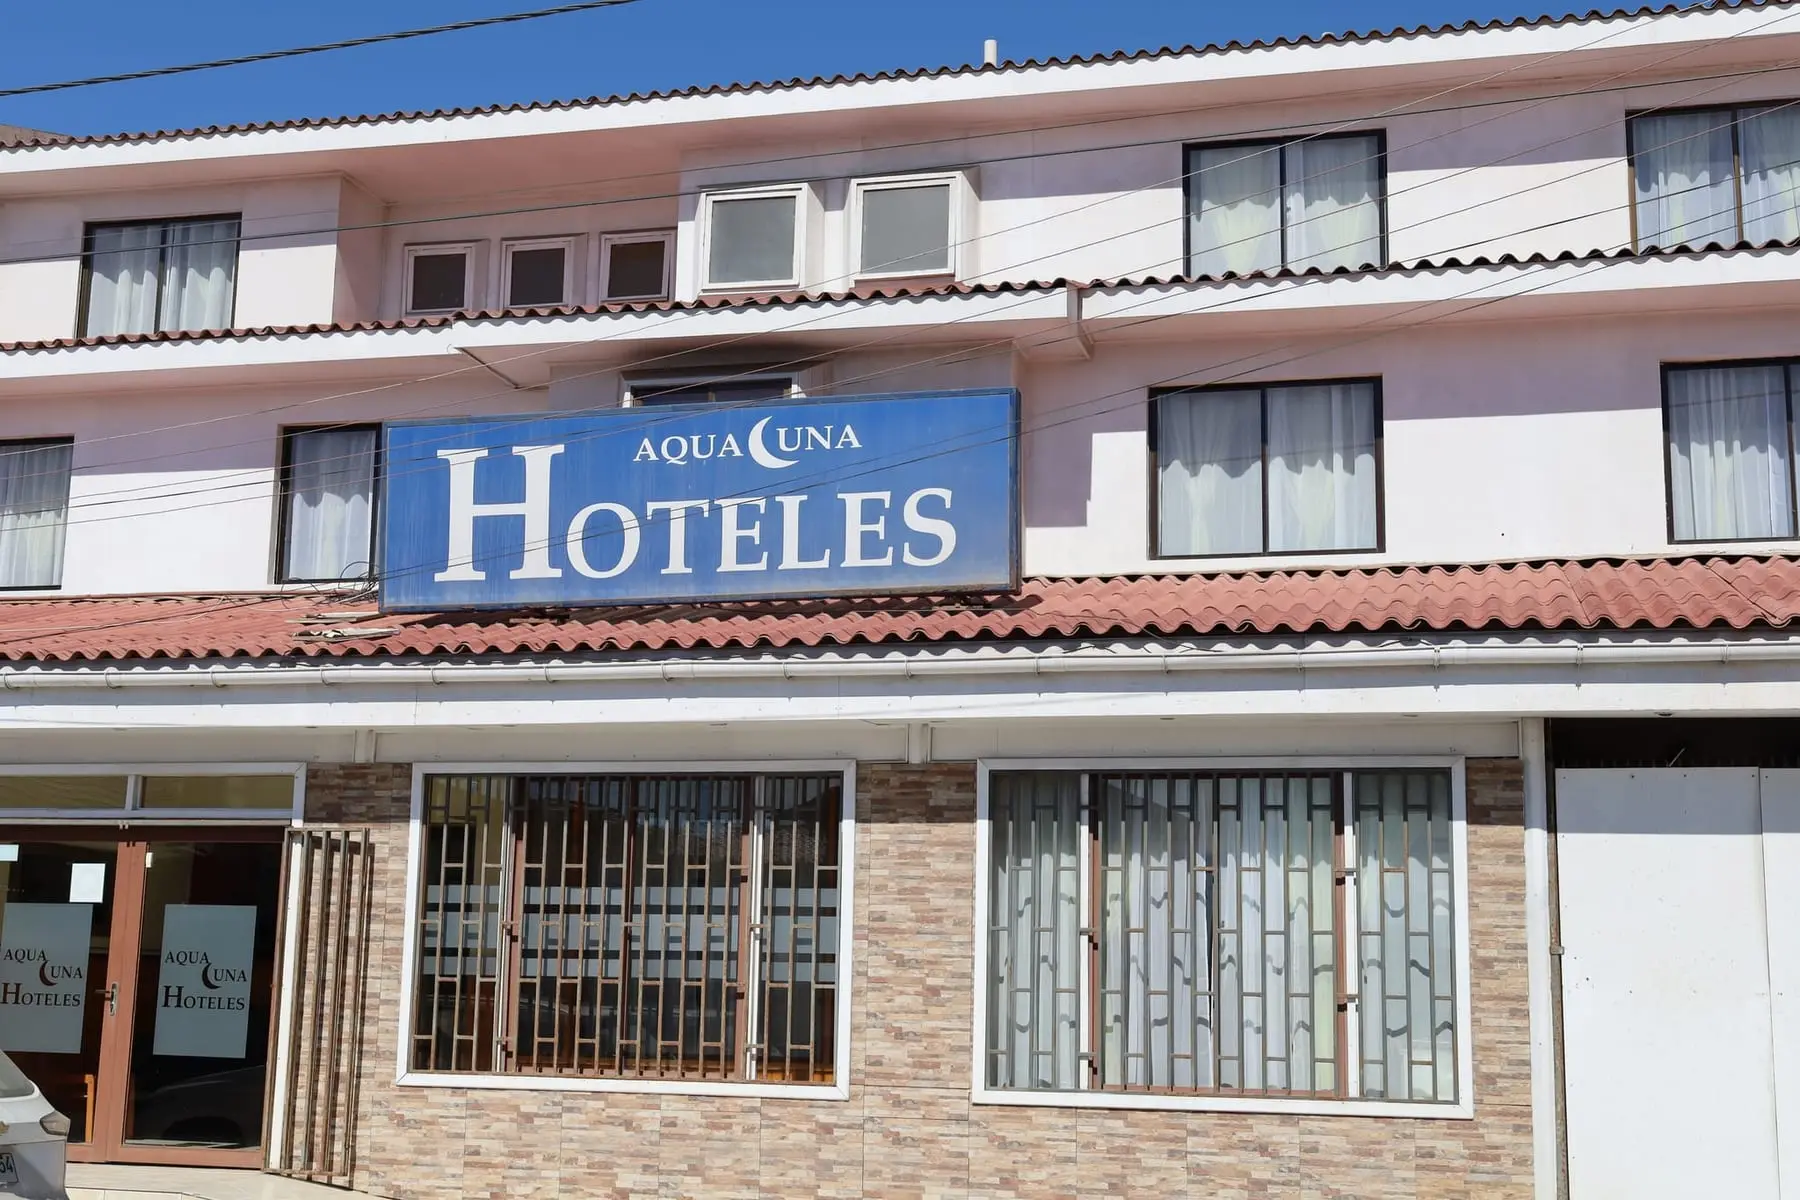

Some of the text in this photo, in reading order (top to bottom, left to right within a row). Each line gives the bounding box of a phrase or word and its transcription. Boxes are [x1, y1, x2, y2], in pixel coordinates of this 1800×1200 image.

[434, 444, 957, 582] HOTELES
[4, 949, 48, 962] AQUA
[164, 951, 209, 965] AQUA
[161, 985, 245, 1010] HOTELES
